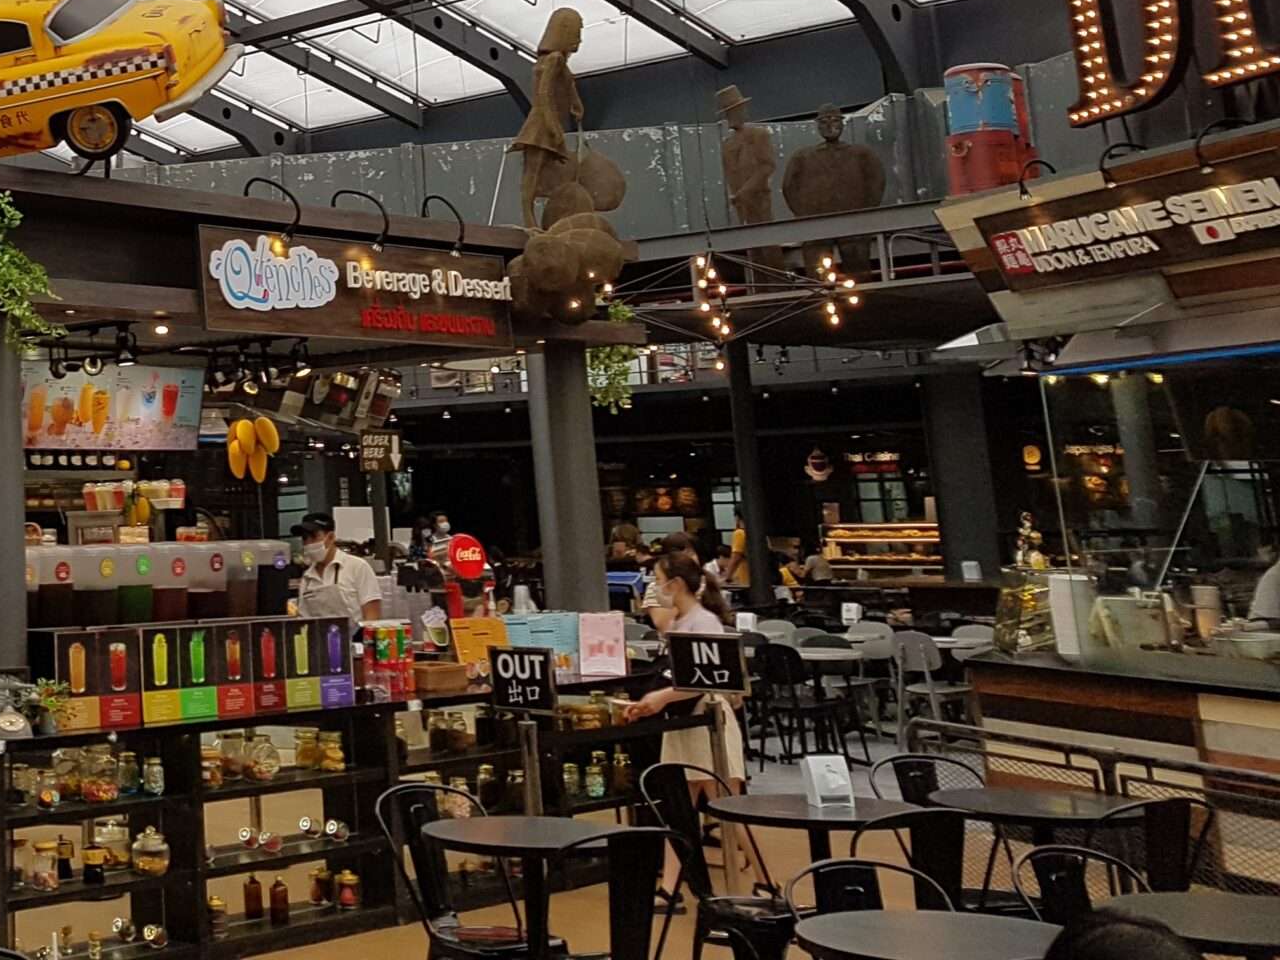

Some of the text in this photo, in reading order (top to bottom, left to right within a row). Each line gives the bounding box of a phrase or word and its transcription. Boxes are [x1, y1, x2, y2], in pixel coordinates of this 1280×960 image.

[1019, 177, 1280, 256] MARUGAME SEIMEN
[1033, 236, 1160, 273] UDON & TEMPURA
[346, 261, 513, 301] Beverage & Dessert
[496, 652, 546, 680] OUT
[691, 641, 720, 666] IN
[690, 667, 730, 685] 入口
[507, 679, 540, 705] 出口
